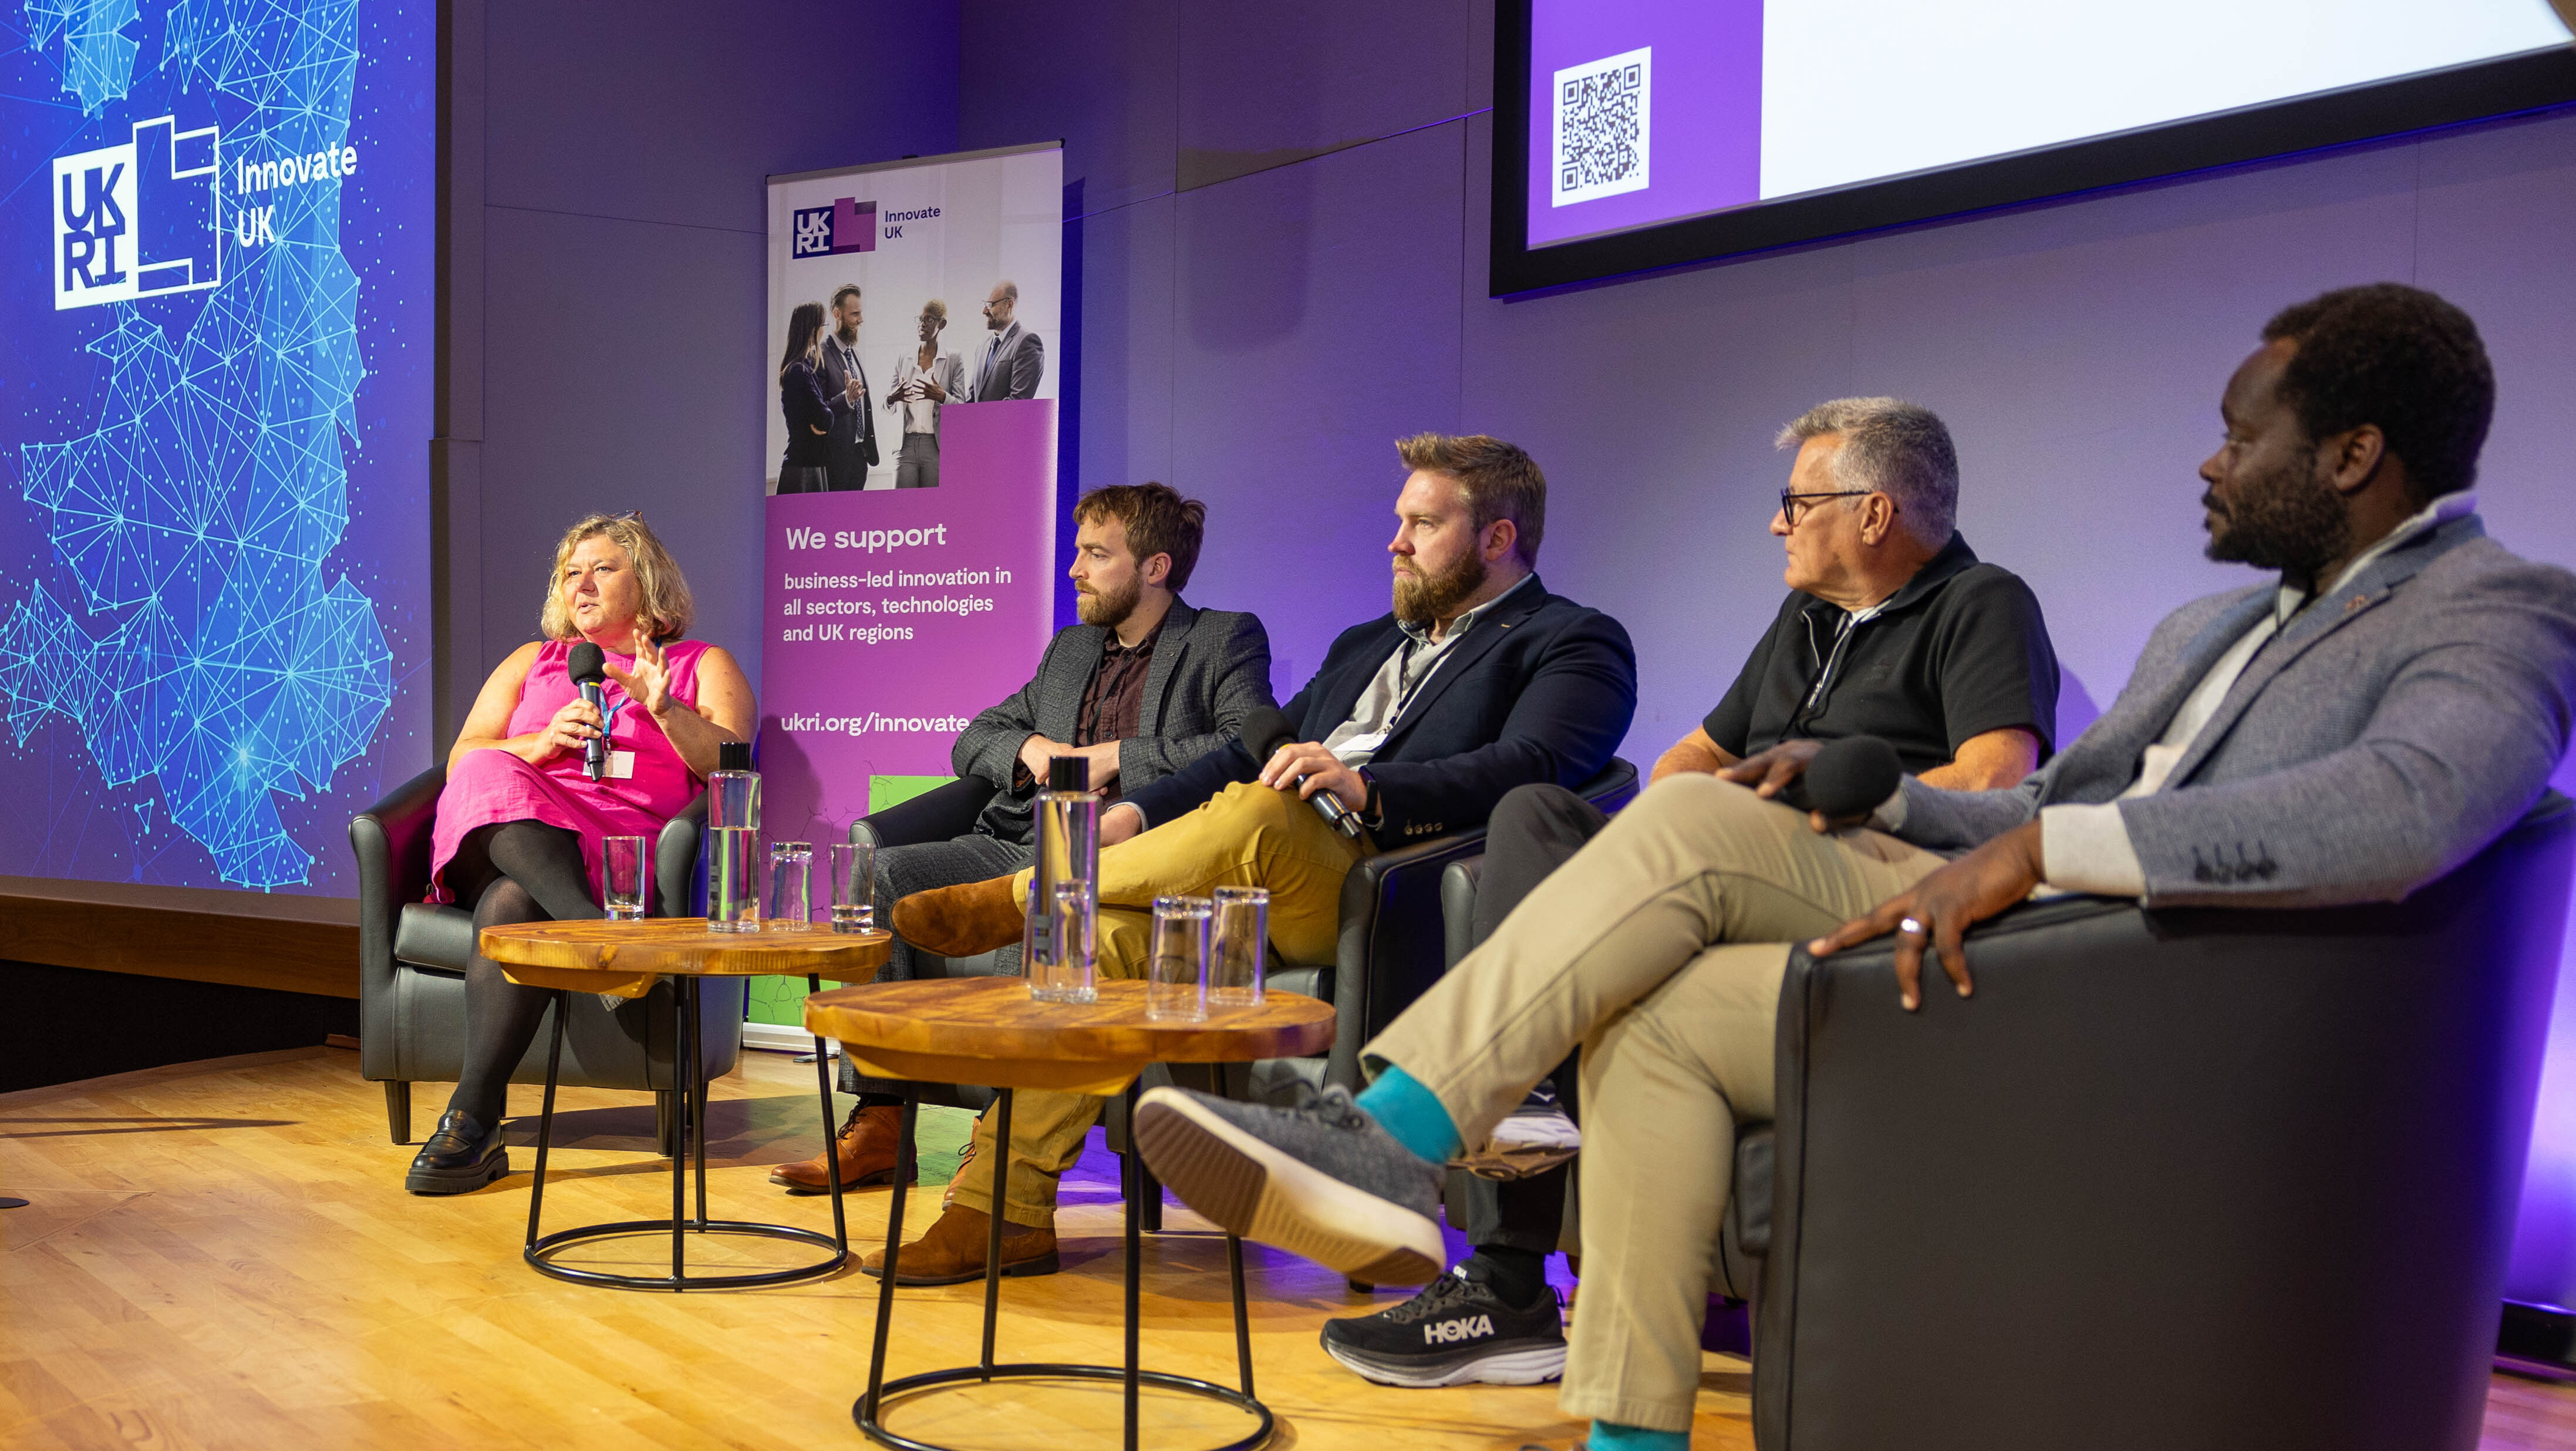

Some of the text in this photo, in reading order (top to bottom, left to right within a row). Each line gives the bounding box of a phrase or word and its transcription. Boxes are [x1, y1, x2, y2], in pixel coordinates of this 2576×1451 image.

[238, 141, 357, 194] Innovate
[62, 162, 125, 233] UK
[237, 204, 275, 247] UK
[797, 211, 830, 234] UK
[885, 207, 940, 222] Innovate
[885, 225, 902, 238] UK
[797, 234, 829, 254] RI
[63, 230, 126, 292] RI
[786, 523, 947, 553] We support
[784, 566, 1011, 590] business-led innovation in
[784, 594, 994, 617] all sectors, technologies
[783, 624, 913, 645] and UK regions
[781, 712, 970, 736] ukri.org/innovate
[1424, 1314, 1494, 1345] HOKA
